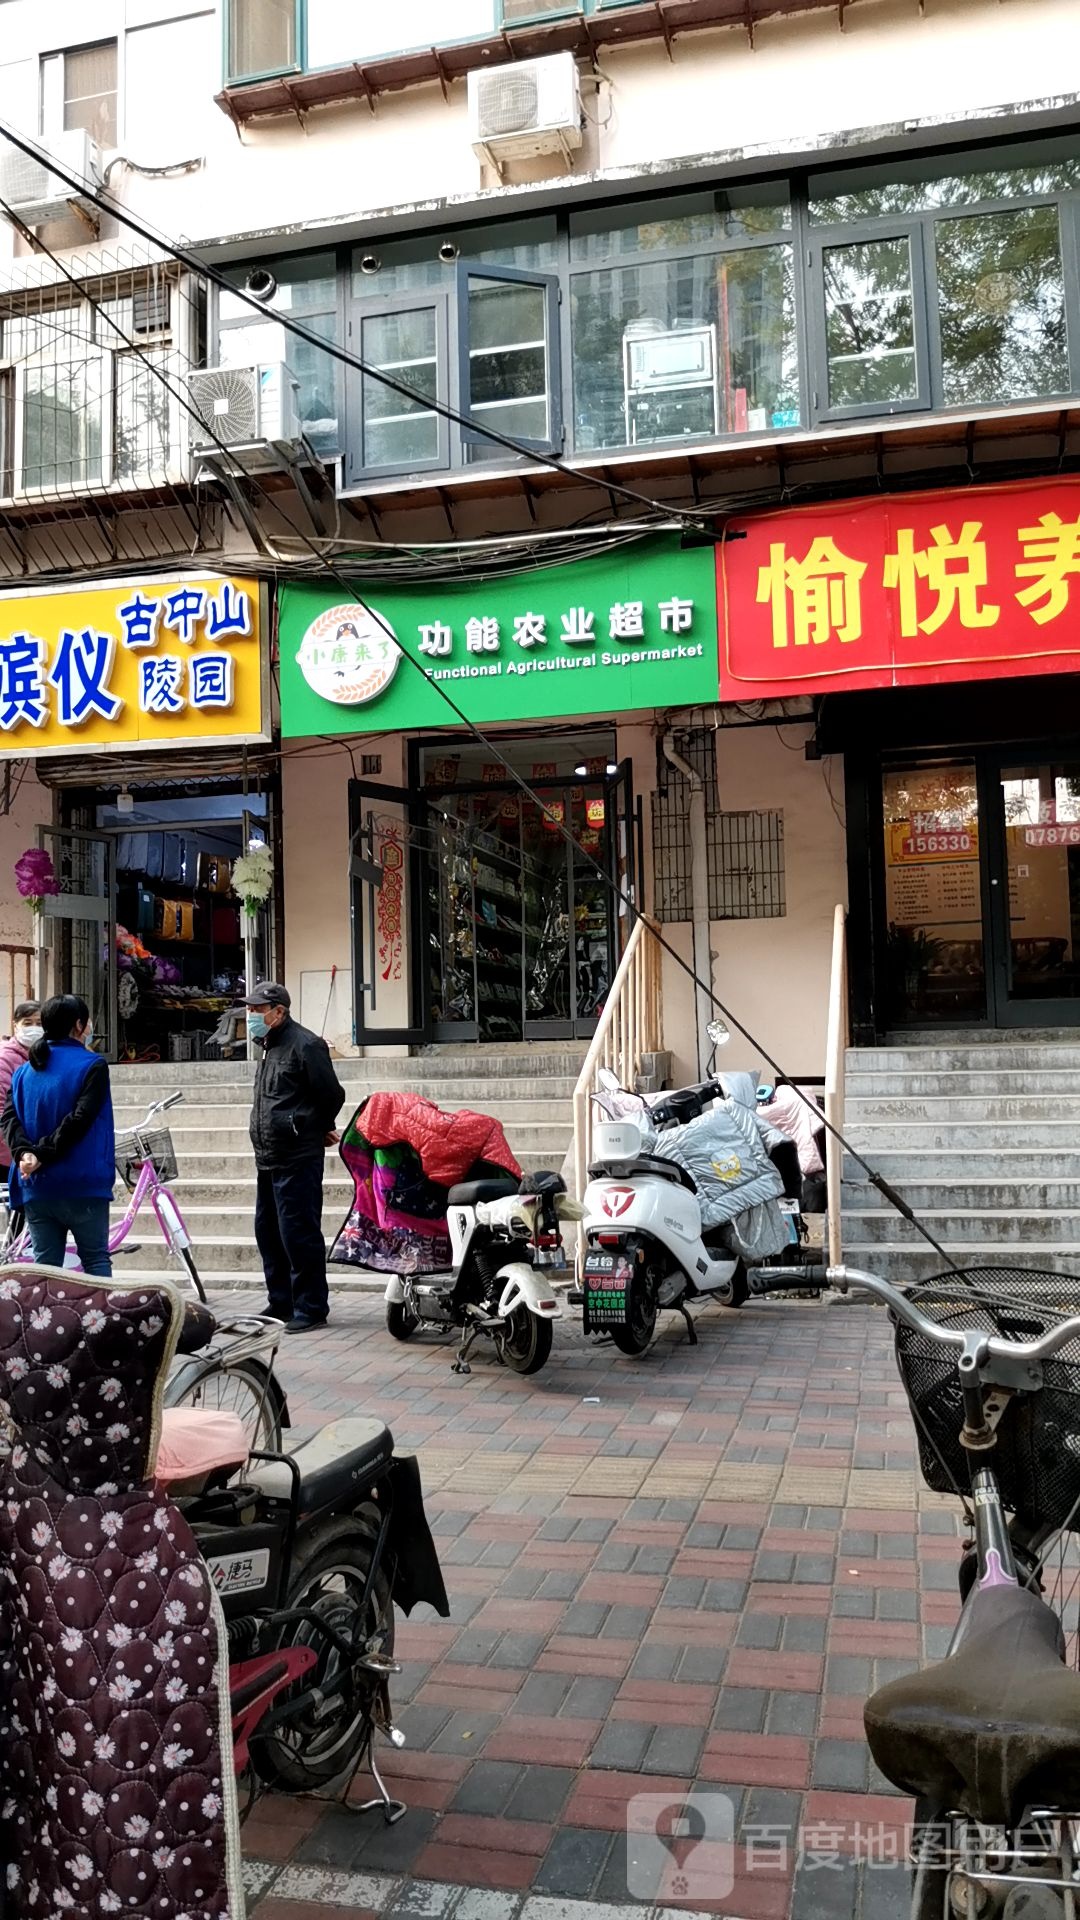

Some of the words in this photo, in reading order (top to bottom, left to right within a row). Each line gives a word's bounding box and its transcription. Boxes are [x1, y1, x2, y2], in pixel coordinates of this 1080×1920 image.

[119, 585, 250, 645] 古中山
[417, 596, 694, 656] 功能农业超市
[307, 640, 390, 665] 小康来了
[424, 661, 502, 681] Functional
[506, 653, 597, 676] Agricultural
[601, 642, 704, 667] Supermarket
[141, 655, 231, 713] 陵园
[907, 835, 970, 853] 156330
